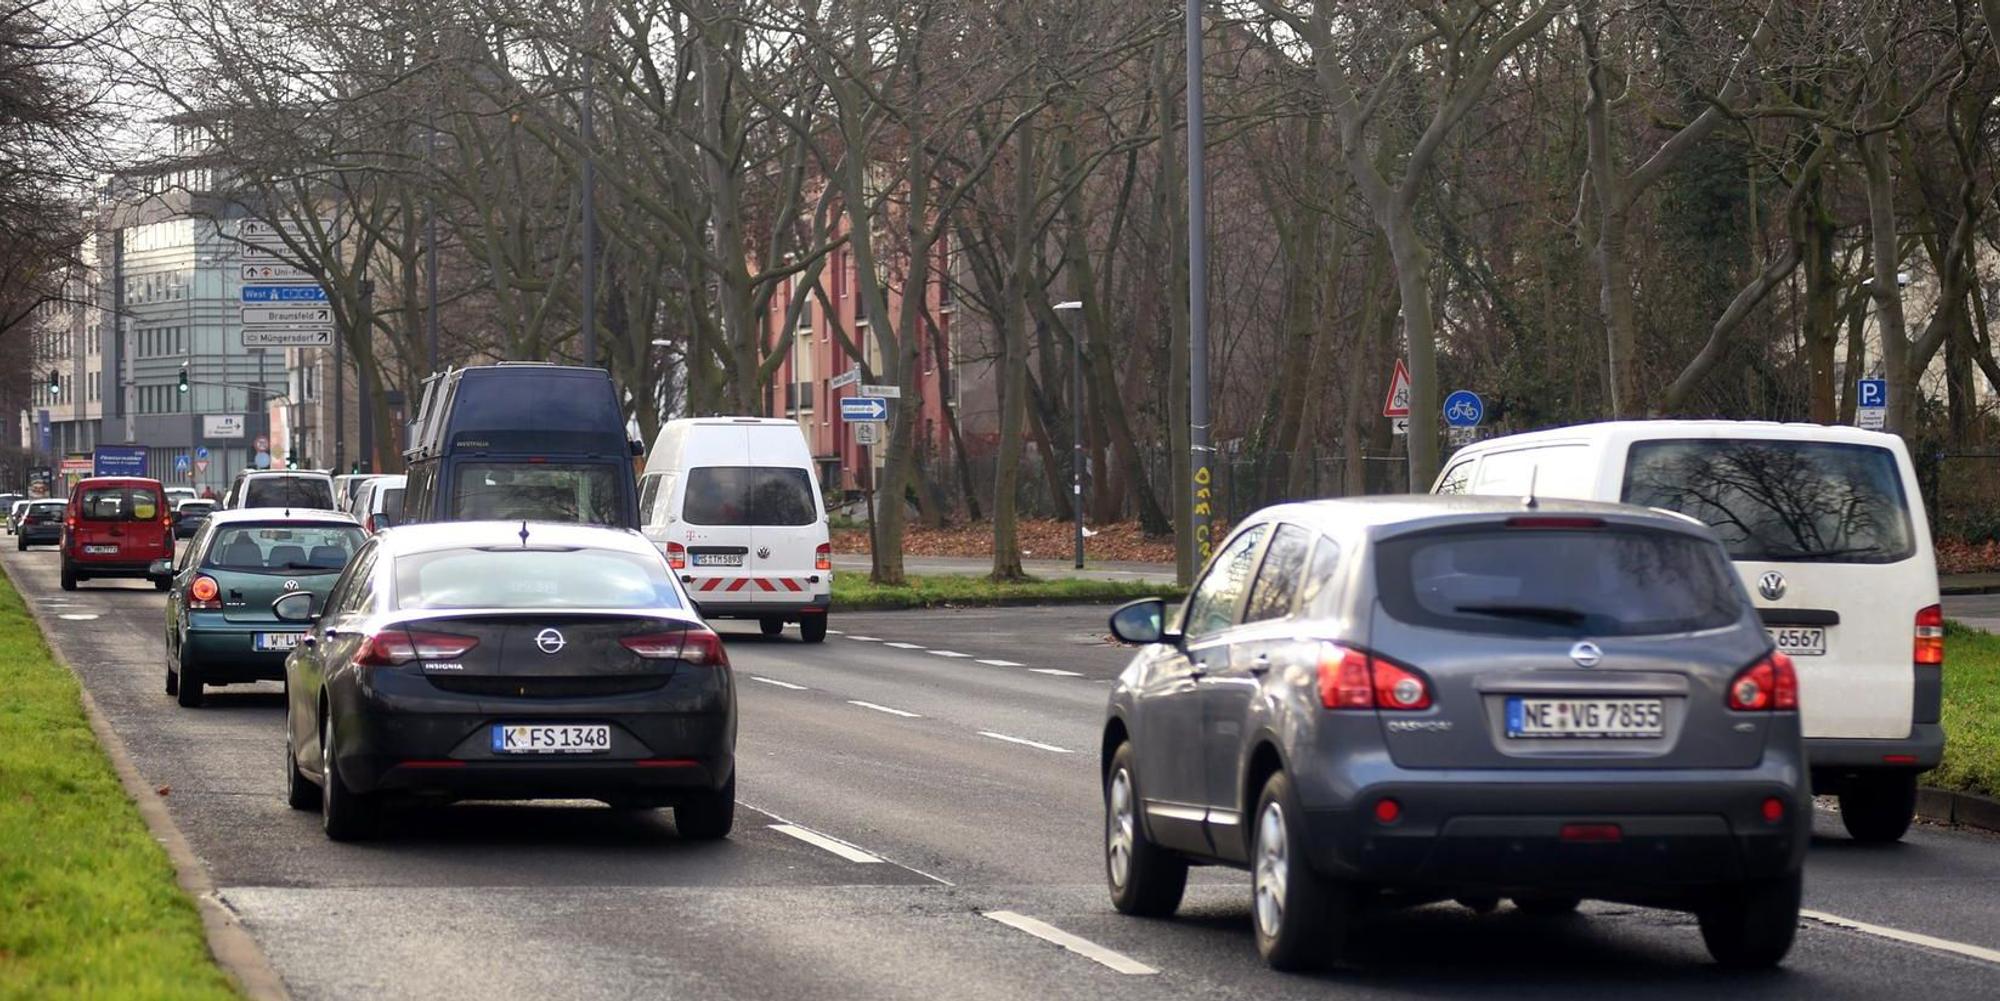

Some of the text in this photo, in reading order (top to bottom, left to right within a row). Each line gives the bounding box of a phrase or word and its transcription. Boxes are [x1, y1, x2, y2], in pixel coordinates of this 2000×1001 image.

[245, 290, 267, 299] West
[268, 312, 314, 320] Braunsfeld
[260, 334, 314, 343] Müngersdorf
[1863, 383, 1878, 404] P
[1778, 629, 1821, 647] 6567
[1524, 703, 1661, 728] NE VG 7855
[504, 728, 608, 747] K FS 1348
